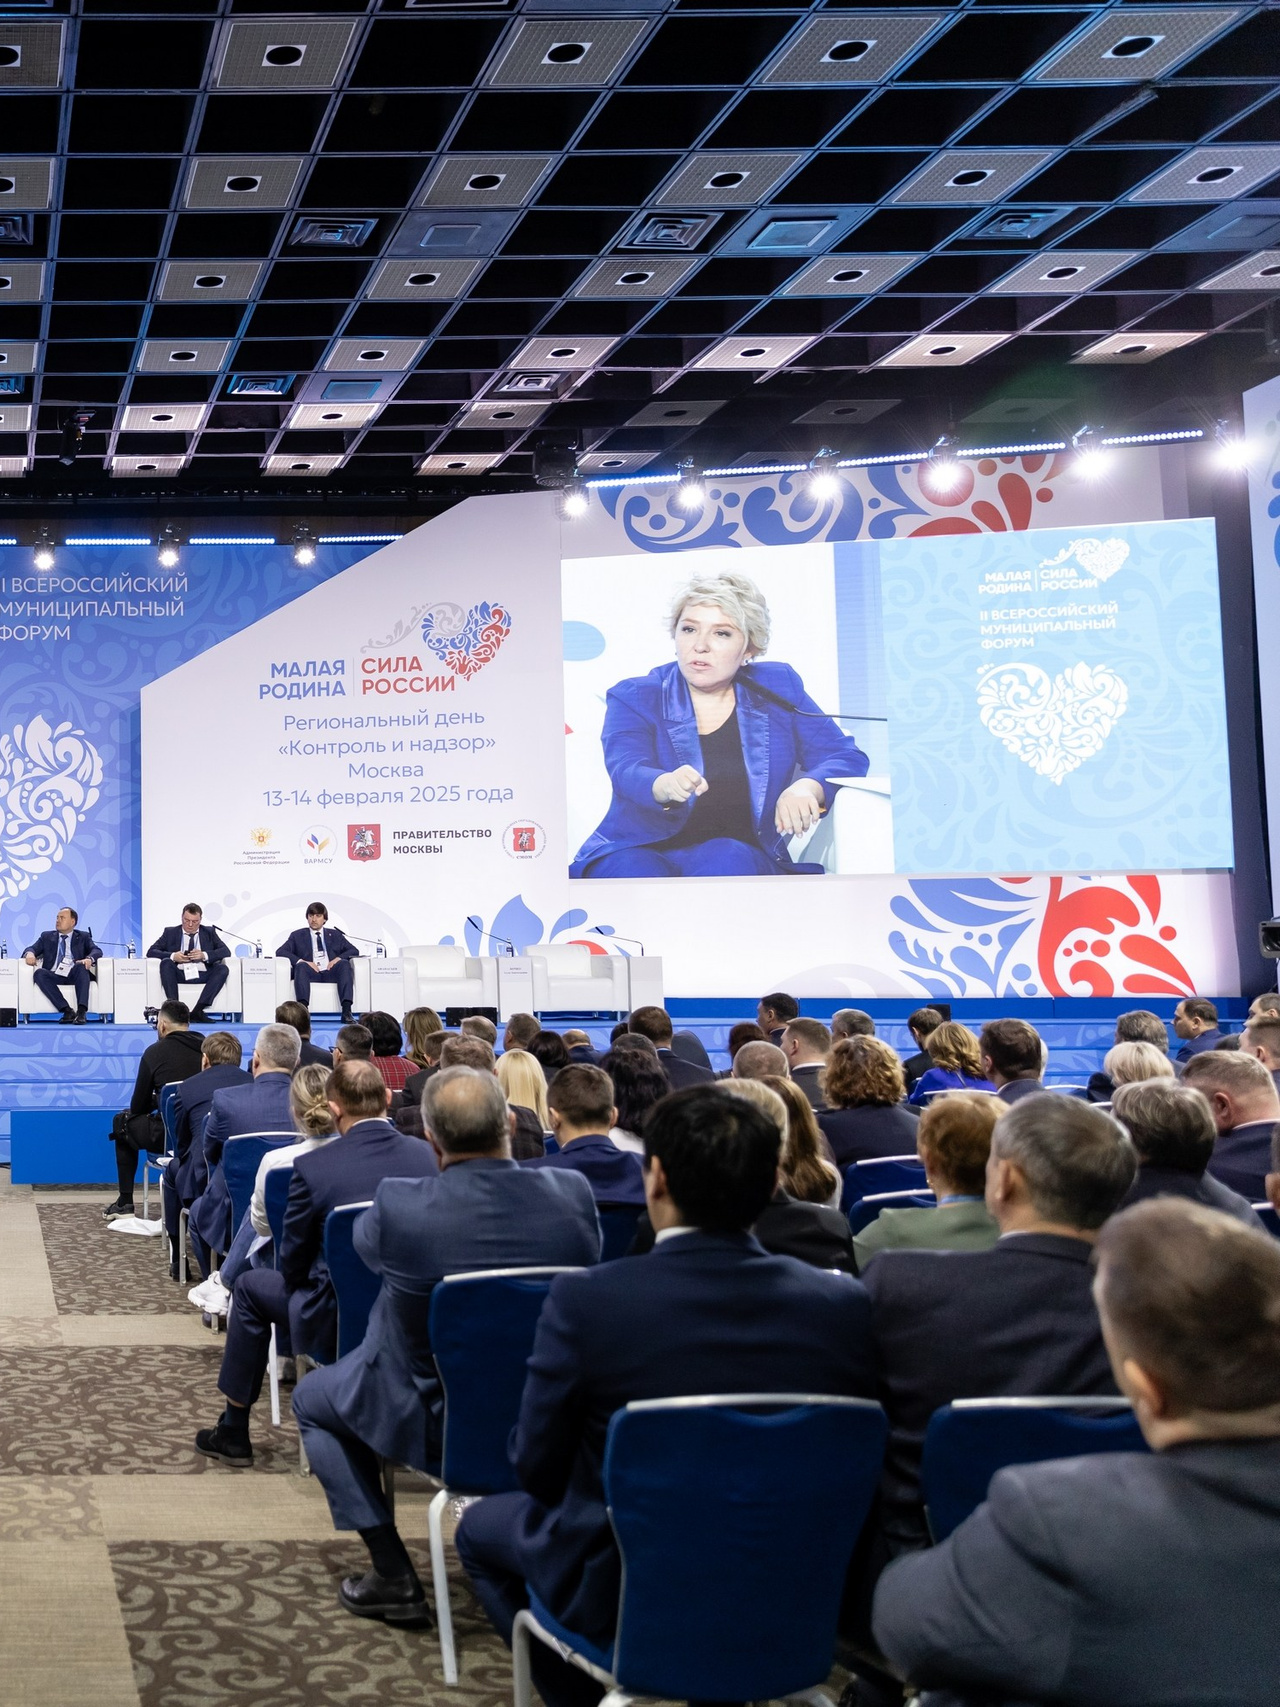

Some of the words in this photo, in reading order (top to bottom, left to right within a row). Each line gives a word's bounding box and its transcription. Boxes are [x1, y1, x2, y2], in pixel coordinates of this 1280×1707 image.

[12, 572, 188, 593] ВСЕРОССИЙСКИЙ
[985, 571, 1031, 582] МАЛАЯ
[1040, 568, 1078, 579] СИЛА
[978, 582, 1032, 595] РОДИНА
[1041, 578, 1098, 591] РОССИИ
[991, 600, 1119, 621] ВСЕРОССИЙСКИЙ
[980, 615, 1116, 635] МУНИЦИПАЛЬНЫЙ
[981, 637, 1035, 650] ФОРУМ
[271, 659, 345, 678] МАЛАЯ
[361, 656, 423, 674] СИЛА
[260, 681, 346, 700] РОДИНА
[362, 676, 455, 695] РОССИИ
[284, 709, 429, 731] Региональный
[435, 712, 485, 728] день
[279, 740, 386, 758] «Контроль
[392, 740, 404, 752] и
[410, 737, 496, 754] надзор»
[348, 763, 424, 779] Москва
[263, 789, 312, 807] 13-14
[317, 788, 404, 809] февраля
[410, 785, 461, 803] 2025
[467, 788, 514, 803] года
[393, 829, 492, 840] ПРАВИТЕЛЬСТВО
[393, 845, 443, 855] МОСКВЫ
